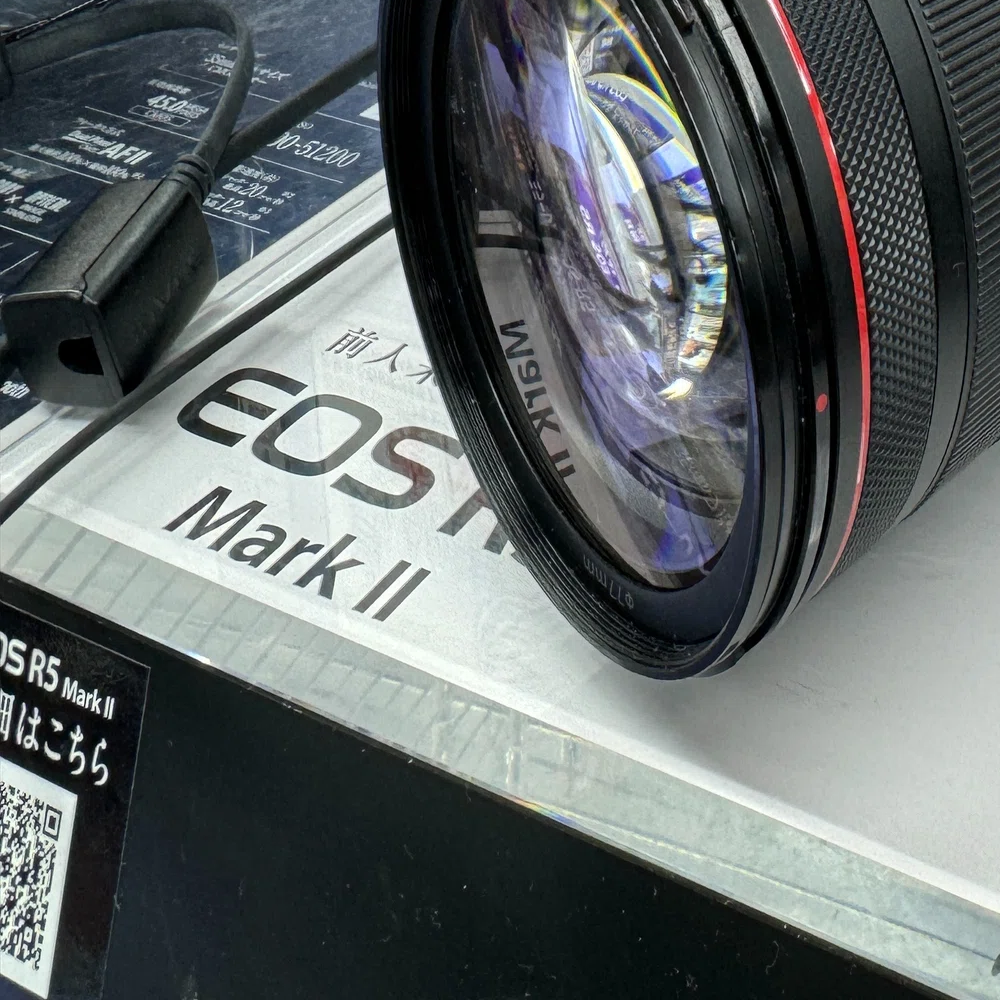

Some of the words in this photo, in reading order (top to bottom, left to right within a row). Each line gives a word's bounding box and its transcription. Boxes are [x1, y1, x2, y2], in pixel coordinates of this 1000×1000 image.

[177, 367, 464, 510] EOS
[162, 485, 364, 600] Mark
[352, 560, 431, 622] II
[28, 648, 61, 692] R5
[61, 677, 102, 714] Mark
[103, 696, 115, 720] II
